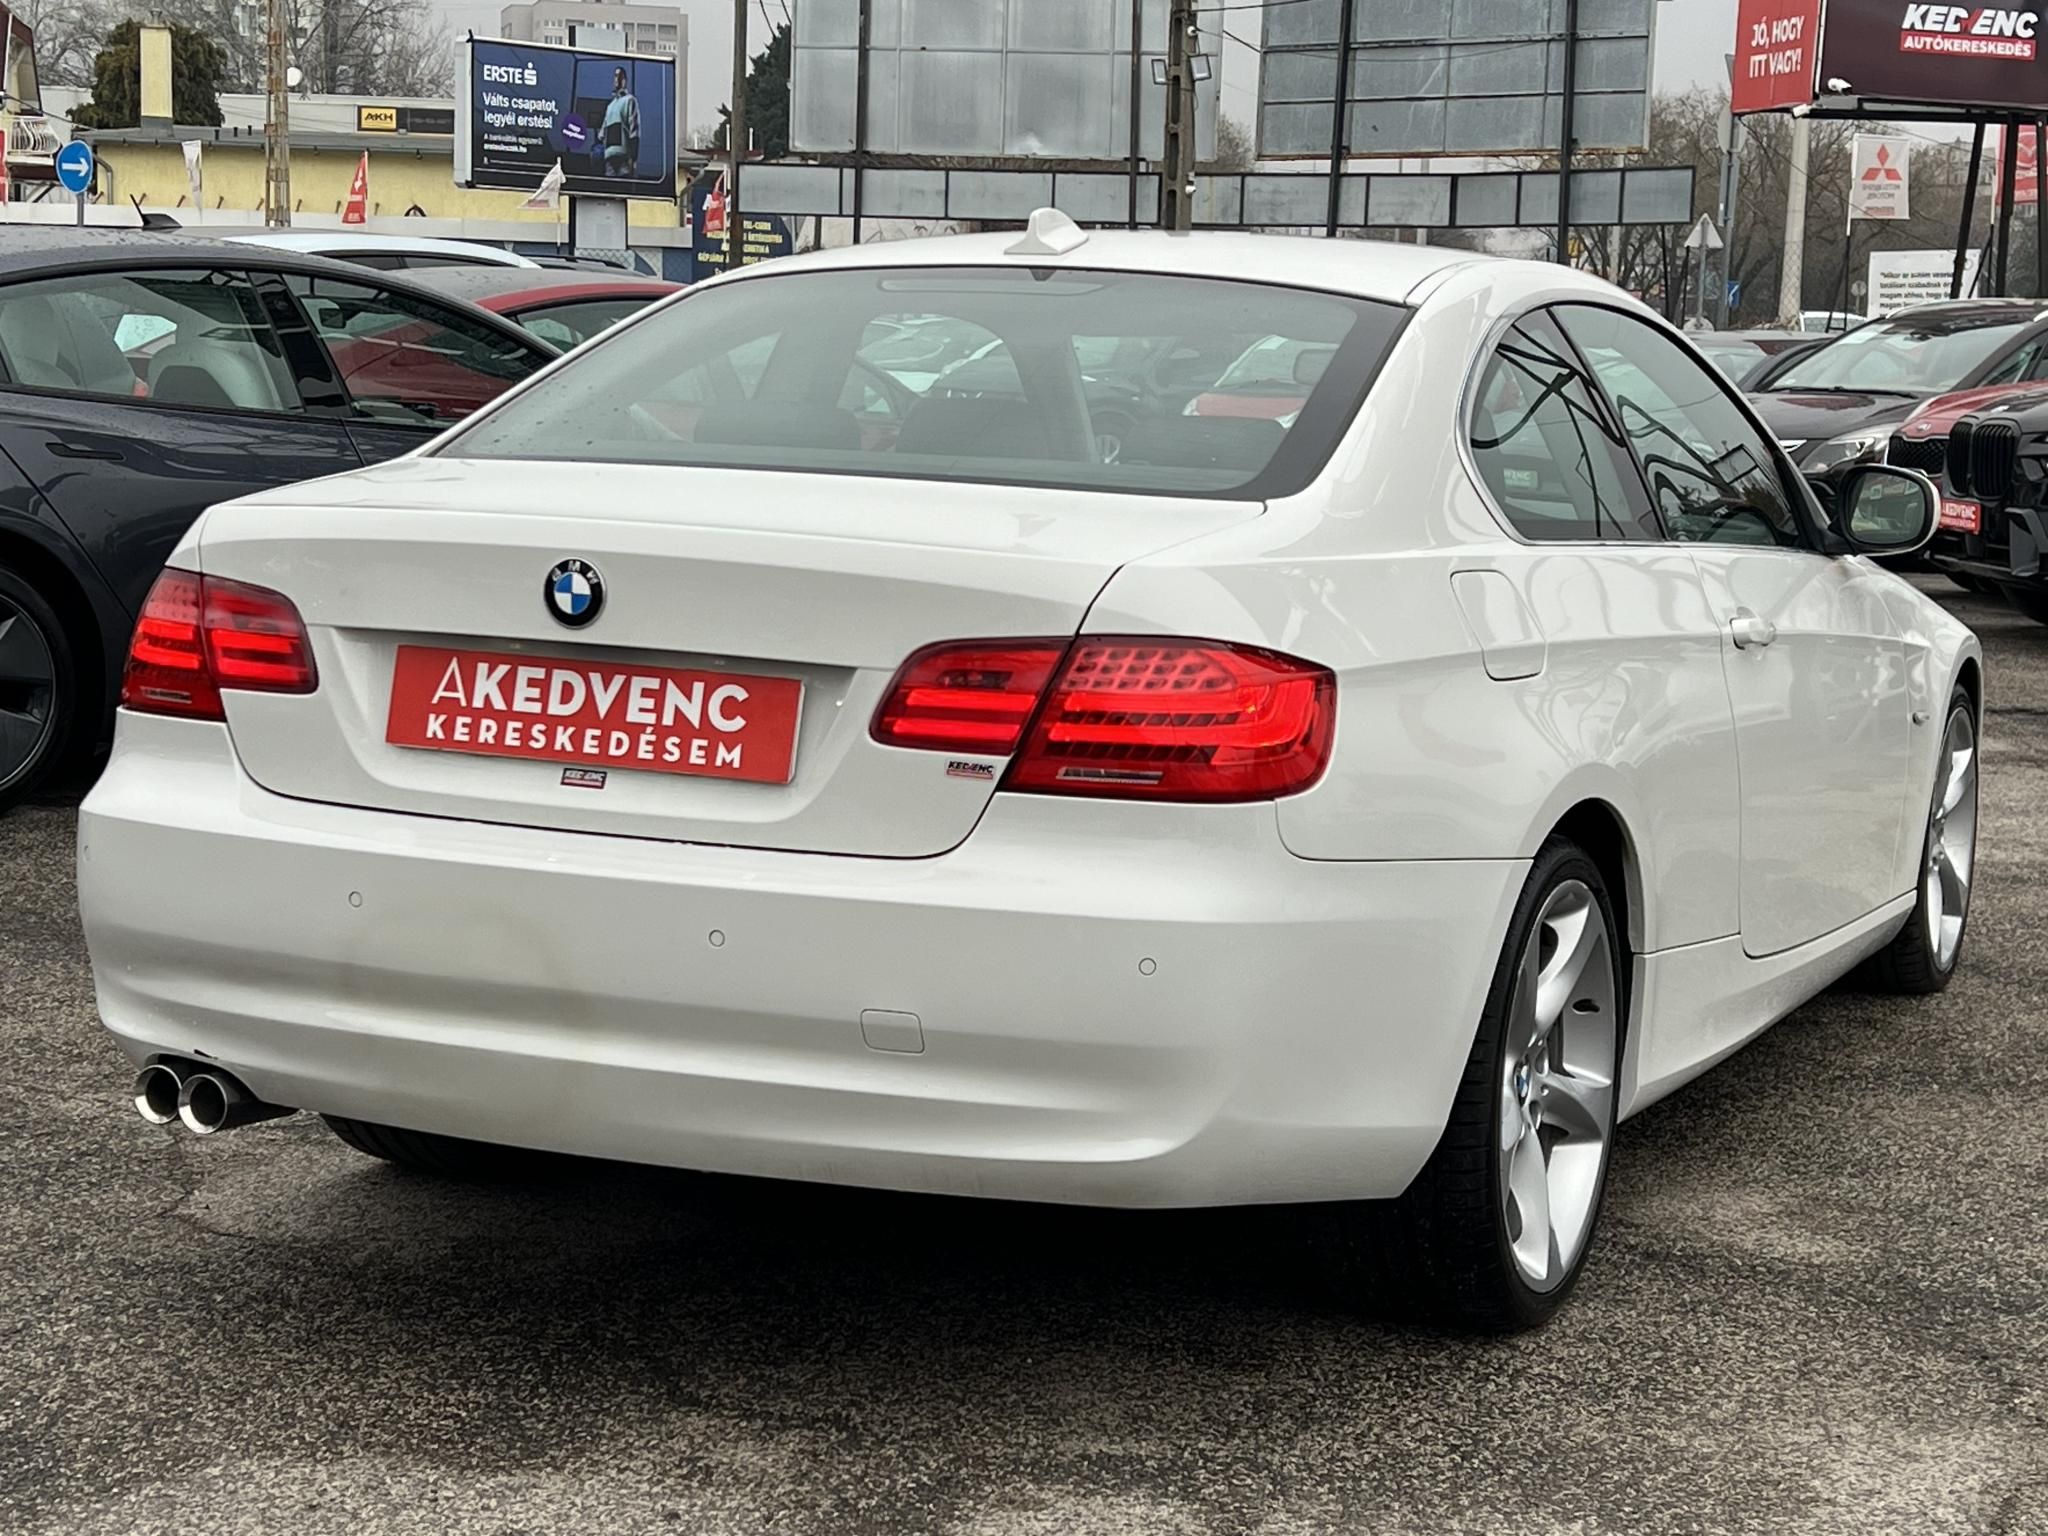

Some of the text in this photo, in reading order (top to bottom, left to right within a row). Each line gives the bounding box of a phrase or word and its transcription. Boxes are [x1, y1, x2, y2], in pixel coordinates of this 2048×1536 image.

[1751, 15, 1805, 49] JÓ, HOGY
[1903, 35, 2032, 57] AUTÓKERESKEDÉS
[483, 64, 523, 84] ERSTE
[1749, 48, 1803, 78] ITT VAGY!
[482, 91, 559, 115] Válts csapatot,
[484, 110, 516, 128] legyél
[517, 115, 553, 129] erstés!
[551, 560, 600, 584] BMW
[426, 713, 743, 769] KERESKEDÉSEM
